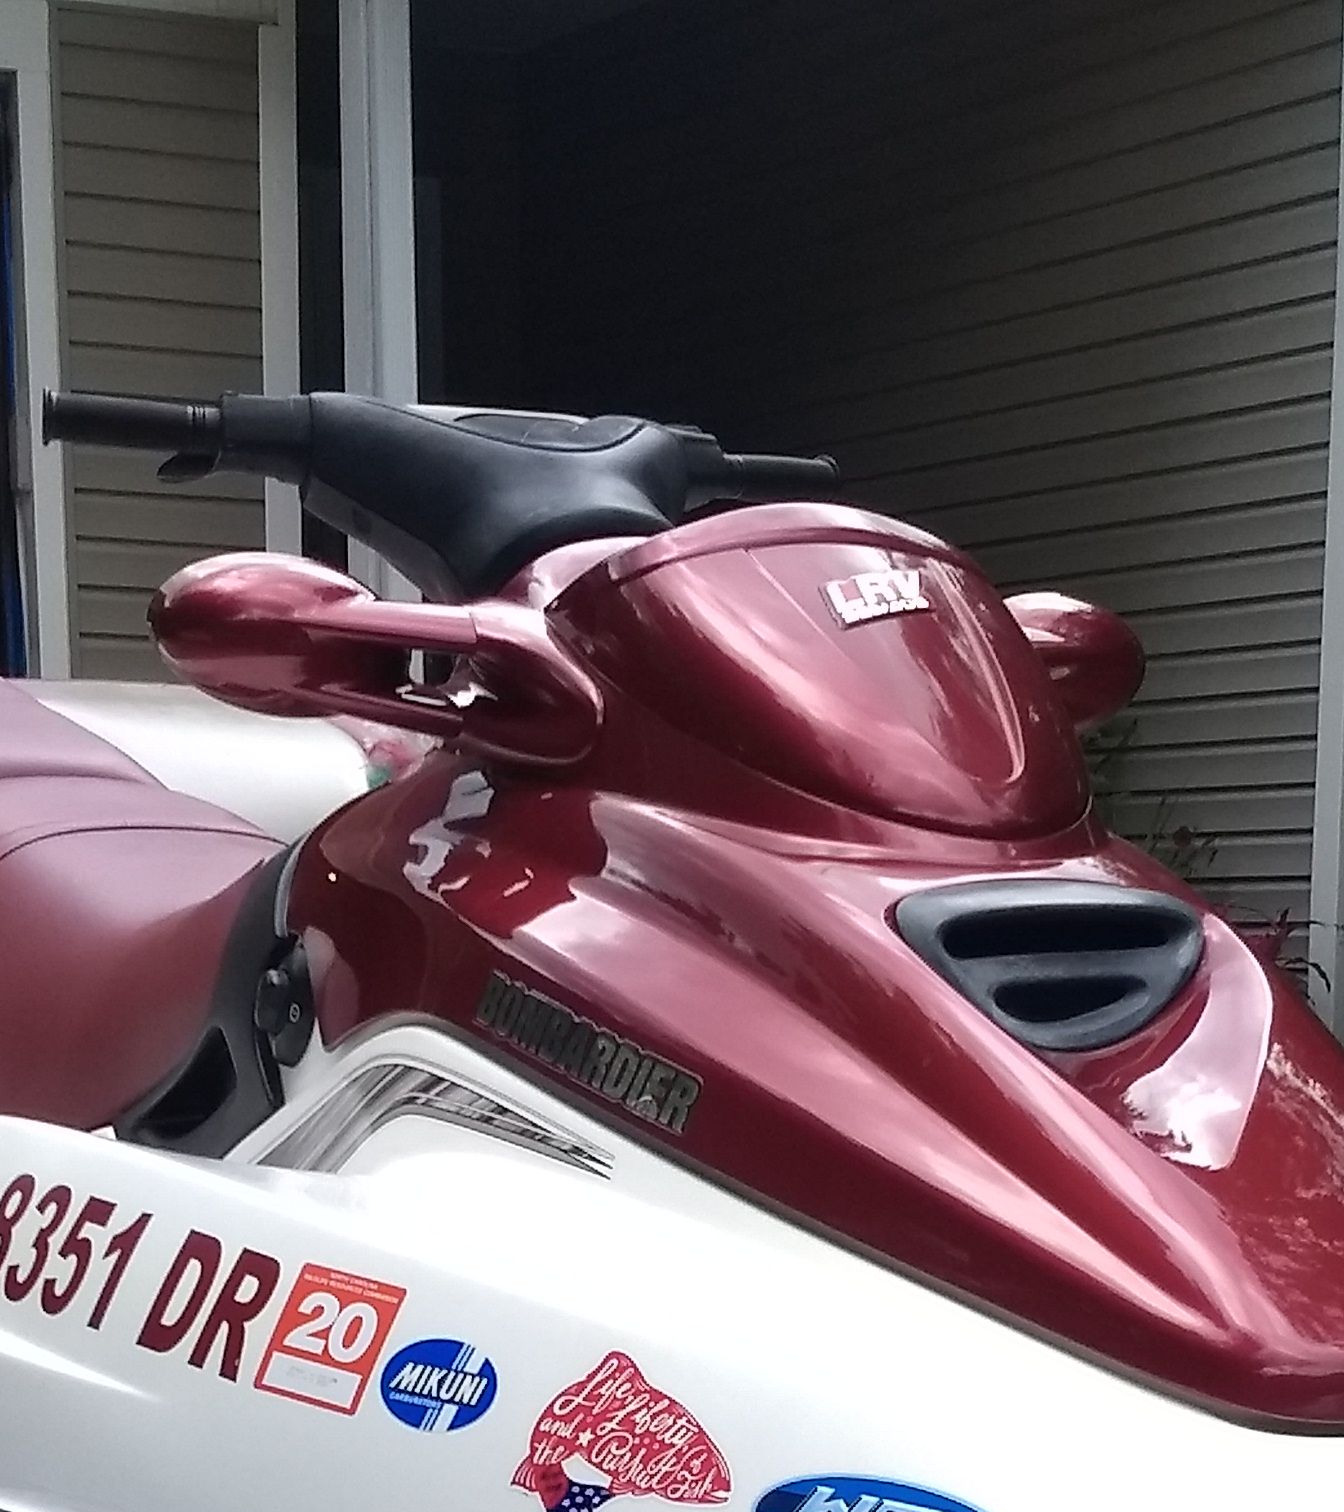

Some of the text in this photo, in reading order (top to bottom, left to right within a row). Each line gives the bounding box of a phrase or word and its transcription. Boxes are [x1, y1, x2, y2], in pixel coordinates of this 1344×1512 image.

[824, 569, 921, 613] LRV
[472, 969, 704, 1137] BOMBARDIER
[136, 1229, 281, 1383] DR
[282, 1290, 379, 1364] 20
[388, 1361, 489, 1407] MIKUNI
[540, 1412, 585, 1439] and
[532, 1436, 570, 1465] the
[591, 1431, 681, 1489] Pursuit
[667, 1466, 718, 1498] Fish
